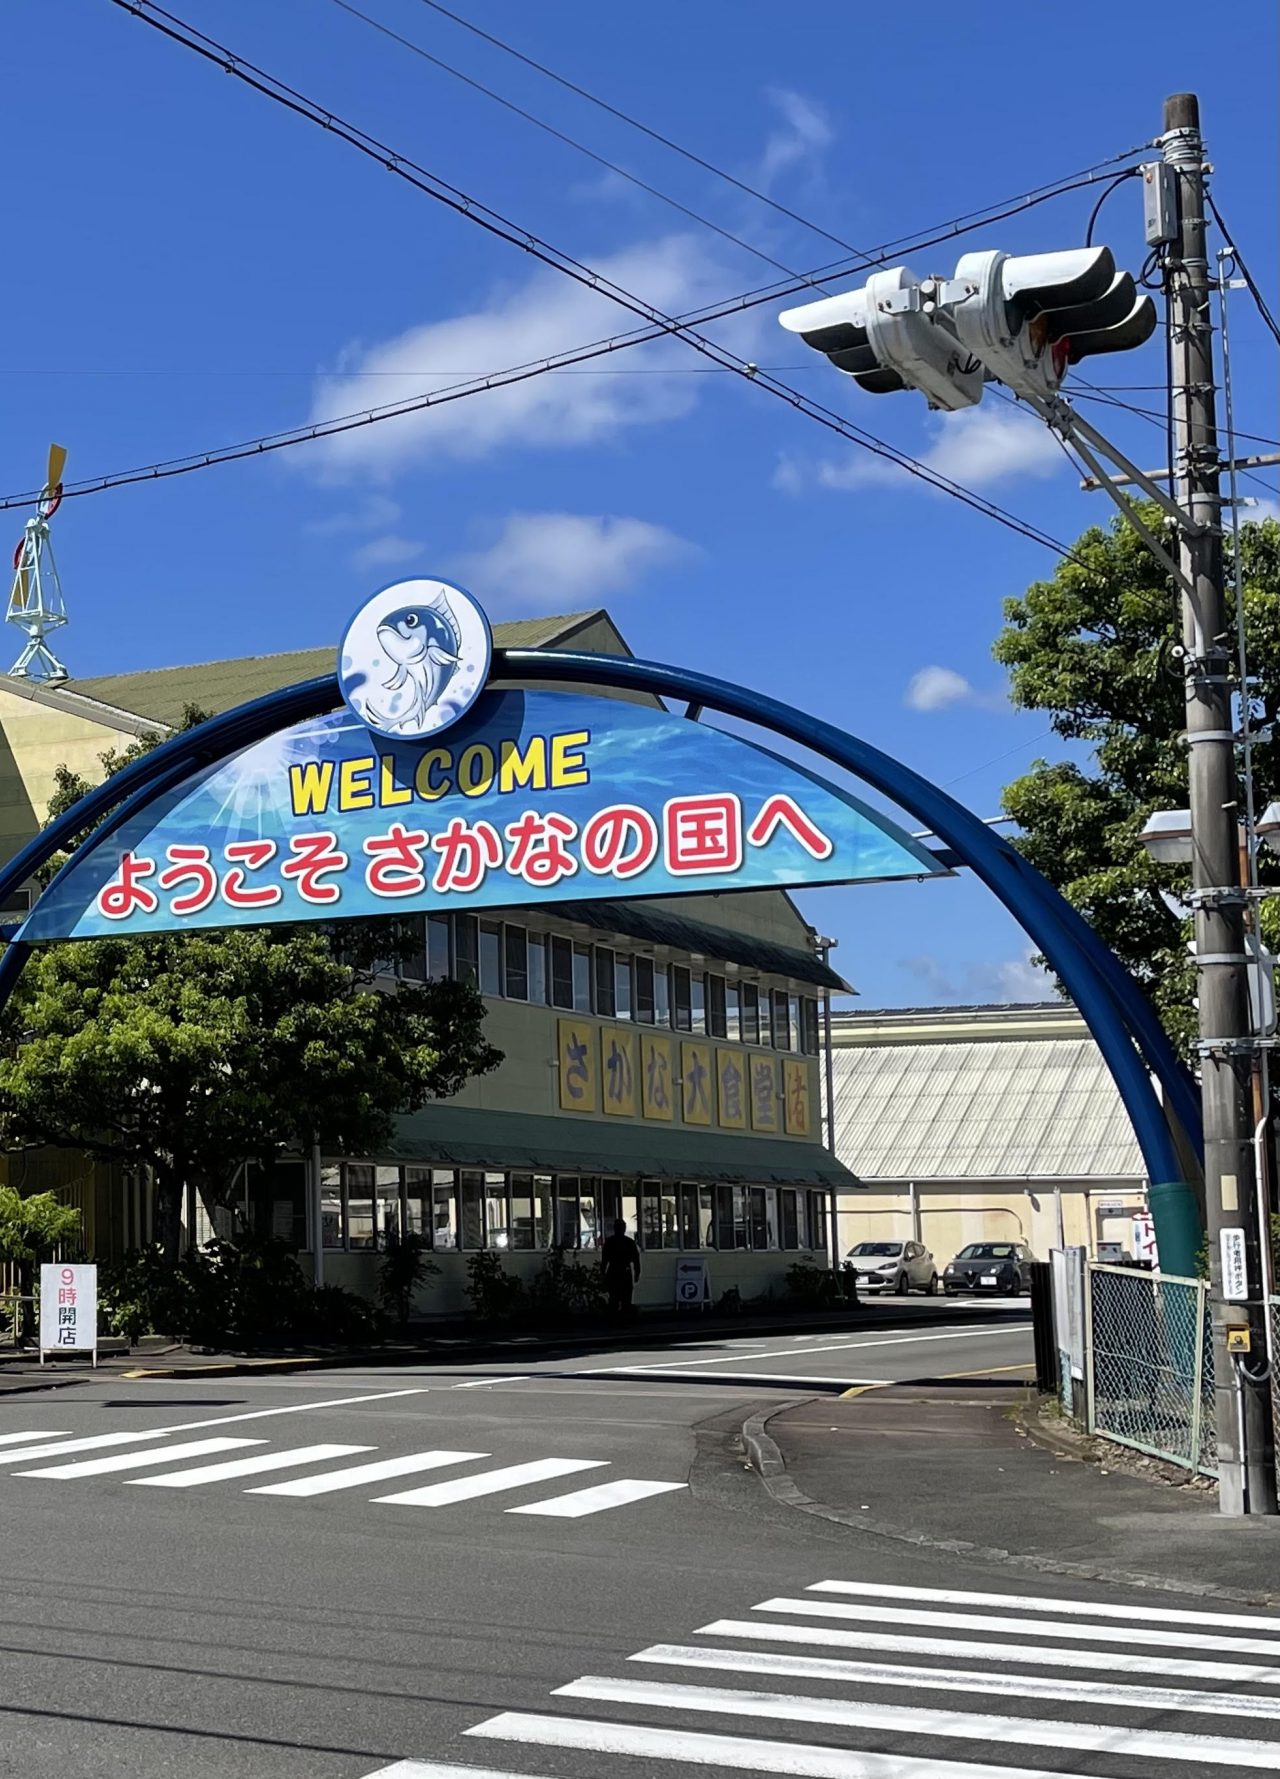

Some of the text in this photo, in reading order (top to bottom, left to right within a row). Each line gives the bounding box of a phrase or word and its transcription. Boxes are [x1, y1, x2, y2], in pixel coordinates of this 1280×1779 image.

[288, 730, 591, 816] WELCOME
[96, 792, 834, 922] ようこそ さかなの国へ
[58, 1268, 77, 1345] 9時開店
